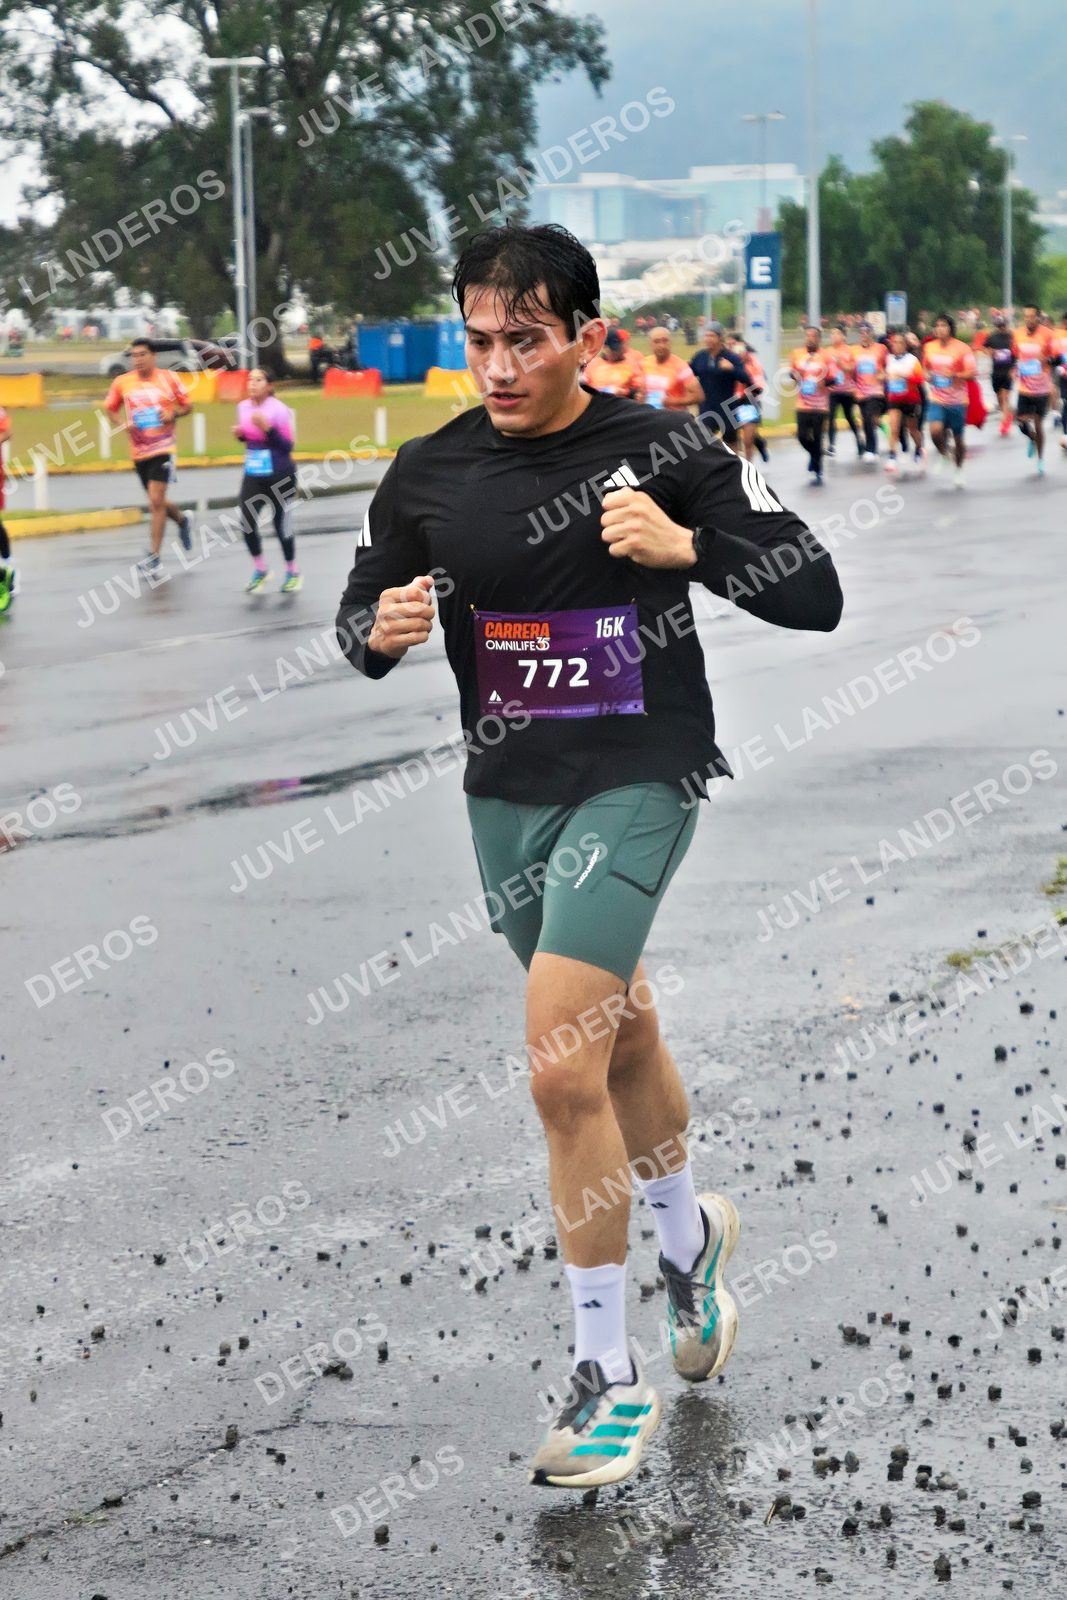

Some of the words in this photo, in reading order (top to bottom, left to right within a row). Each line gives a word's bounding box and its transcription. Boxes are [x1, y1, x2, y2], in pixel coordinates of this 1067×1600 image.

[750, 256, 772, 284] E
[484, 621, 550, 639] CARRERA
[595, 615, 625, 638] 15K
[518, 657, 589, 688] 772
